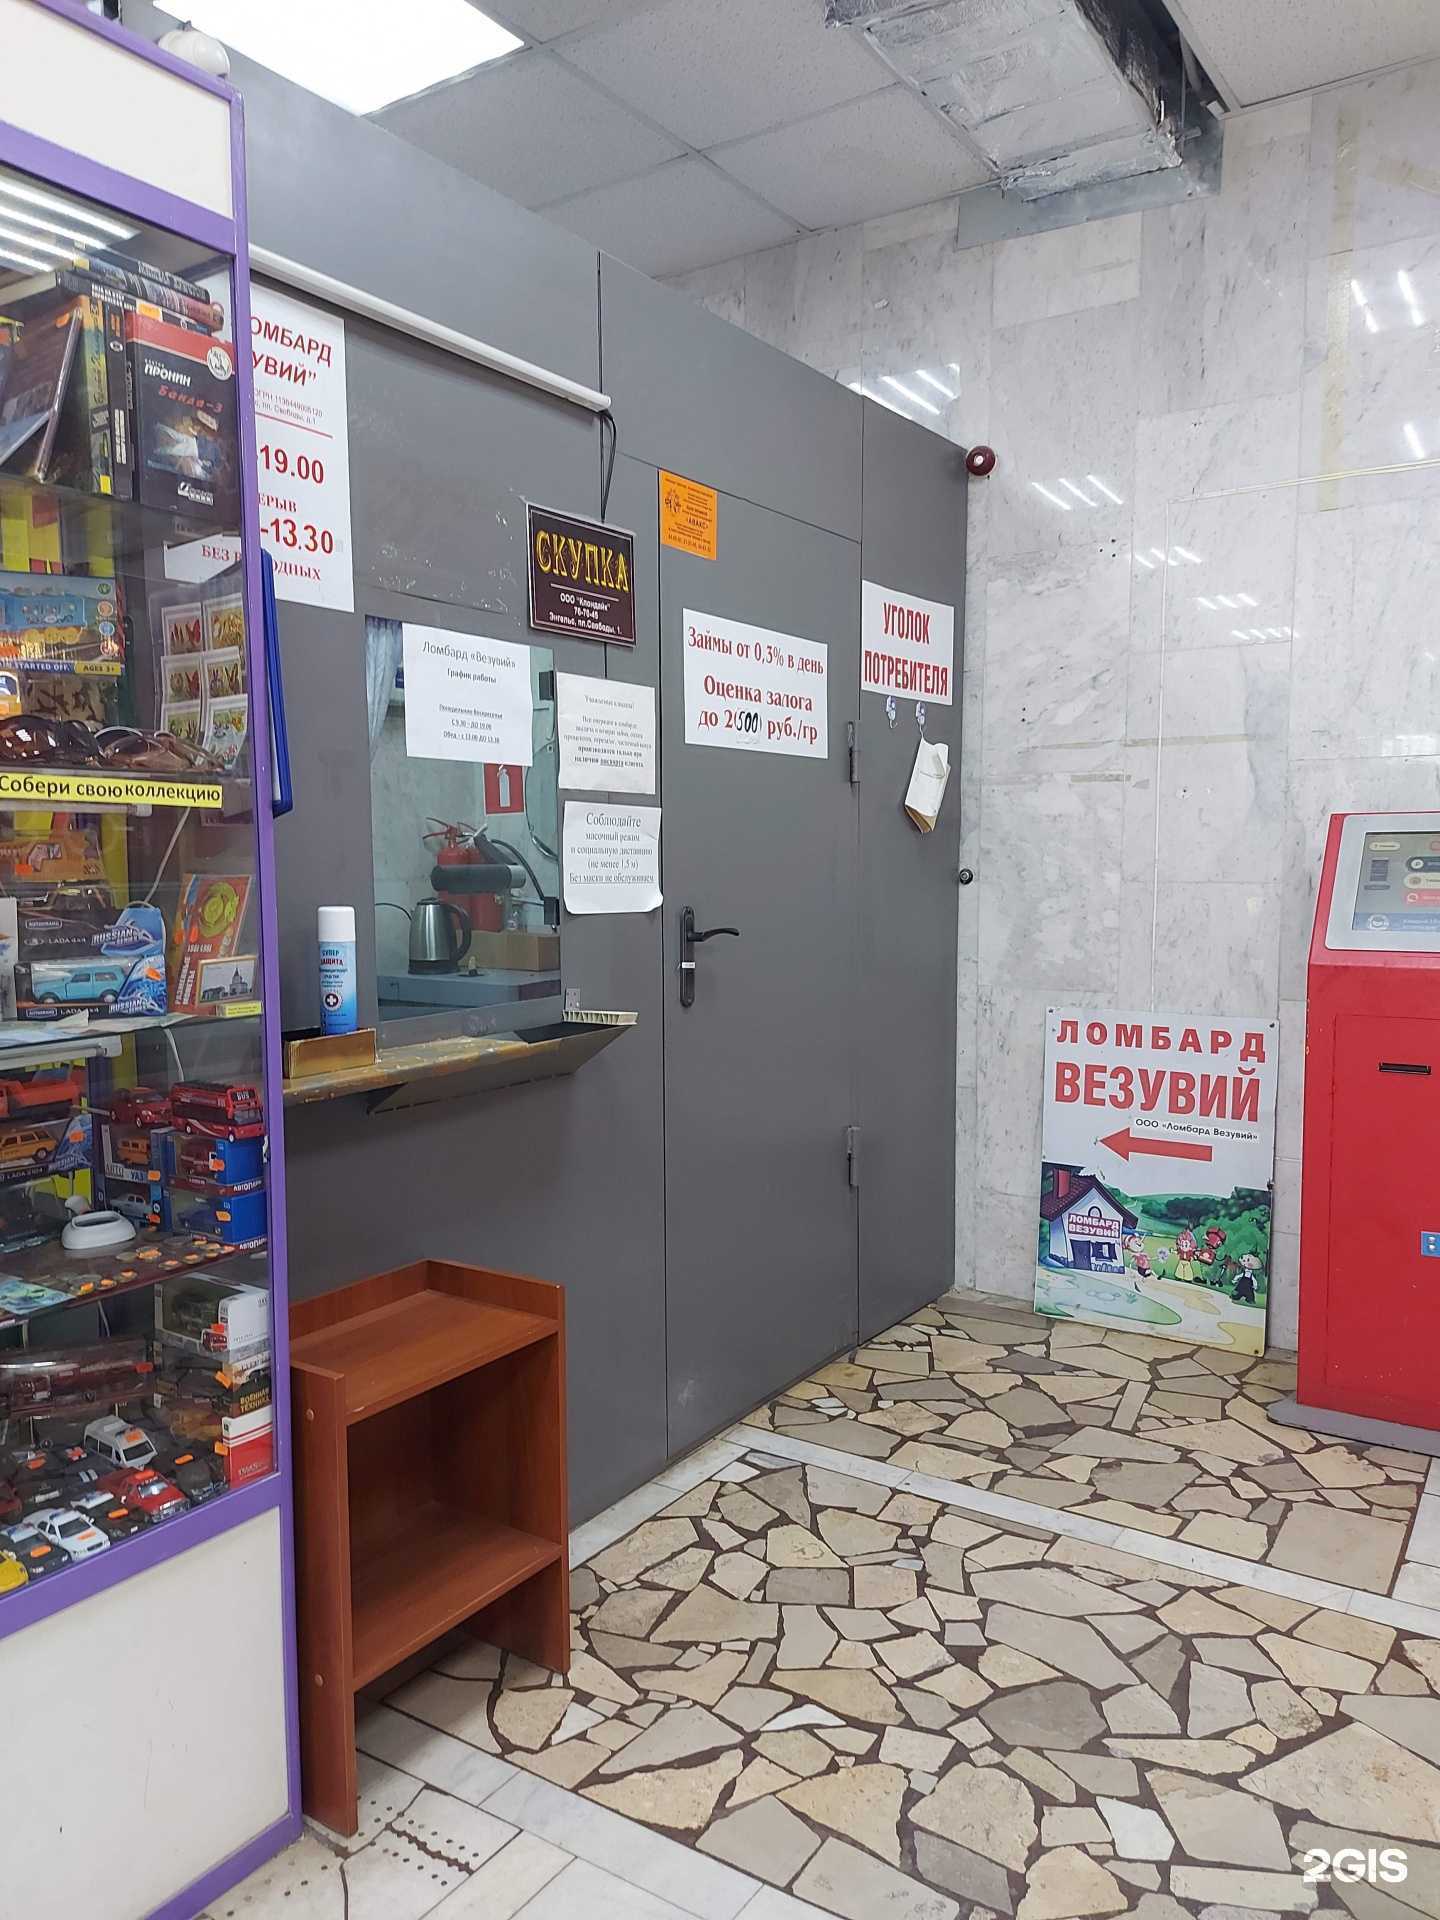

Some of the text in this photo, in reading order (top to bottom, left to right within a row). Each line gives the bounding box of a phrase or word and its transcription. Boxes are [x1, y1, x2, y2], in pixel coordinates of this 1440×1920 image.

[251, 316, 332, 368] ОМБАРД
[144, 363, 191, 387] ПРОНИН
[158, 385, 224, 413] Банда-3
[259, 444, 324, 484] 19.00
[259, 492, 297, 513] ЕРЫВ
[260, 517, 333, 555] -13.30
[202, 544, 231, 562] БЕЗ
[535, 529, 630, 593] СКУПКА
[560, 592, 575, 605] ООО
[883, 601, 930, 645] УГОЛОК
[422, 641, 516, 668] Ломбард «Везувий»
[687, 625, 824, 675] Займы от 0,3% в день
[447, 668, 497, 684] График работы
[864, 650, 948, 697] ПОТРЕБИТЕЛЯ
[703, 675, 813, 712] Оценка залога
[697, 709, 719, 733] до
[767, 718, 818, 745] руб./гр
[0, 775, 220, 802] Собери свою коллекцию
[586, 811, 641, 828] Соблюдайте
[585, 831, 619, 841] масочный
[92, 929, 134, 945] RUSSIAN
[1056, 1019, 1266, 1063] ЛОМБАРД
[236, 1091, 250, 1101] BUS
[1054, 1061, 1261, 1122] ВЕЗУВИЙ
[1135, 1118, 1258, 1140] ООО «Ломбард Везувий»
[1069, 1214, 1119, 1230] ЛОМБАРД
[1069, 1223, 1119, 1238] ВЕЗУВИЙ
